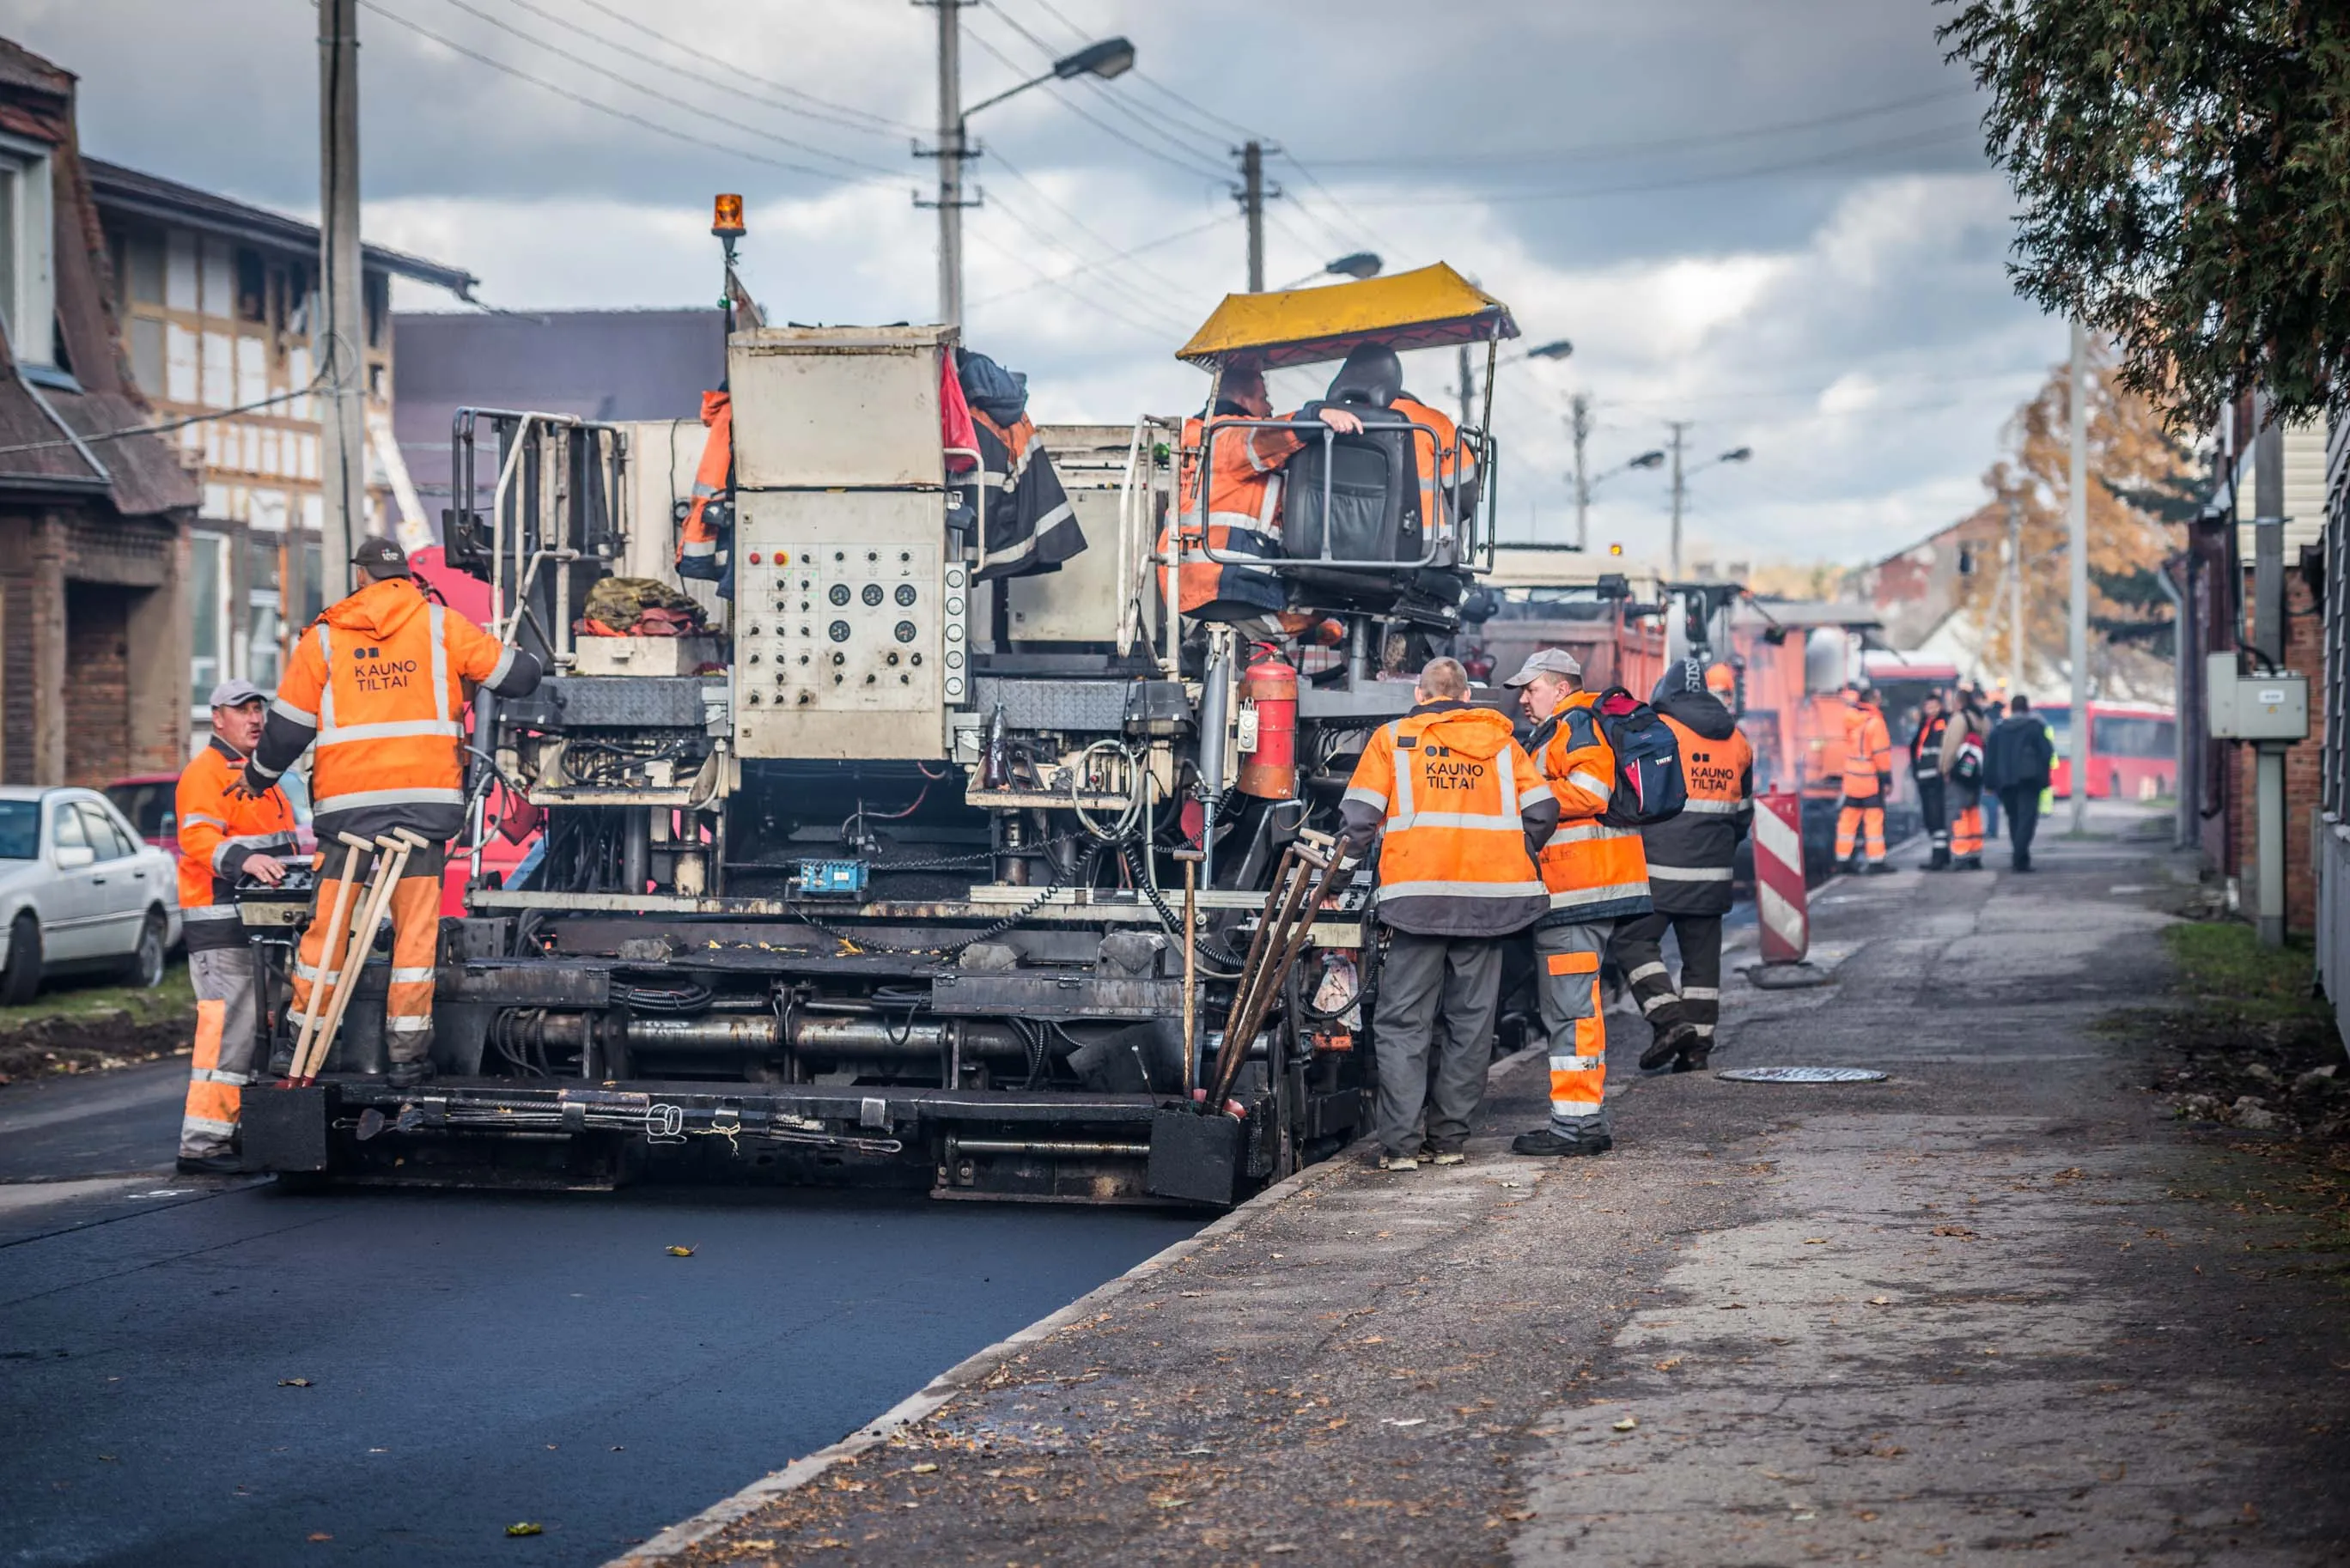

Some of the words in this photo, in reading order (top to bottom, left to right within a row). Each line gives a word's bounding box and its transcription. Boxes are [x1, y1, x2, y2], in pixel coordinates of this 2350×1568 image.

[355, 659, 417, 677] KAUNO
[356, 675, 407, 691] TILTAI
[1426, 763, 1483, 776] KAUNO
[1691, 767, 1733, 780] KAUNO
[1427, 775, 1474, 789] TILTAI
[1691, 778, 1726, 790] TILTAI
